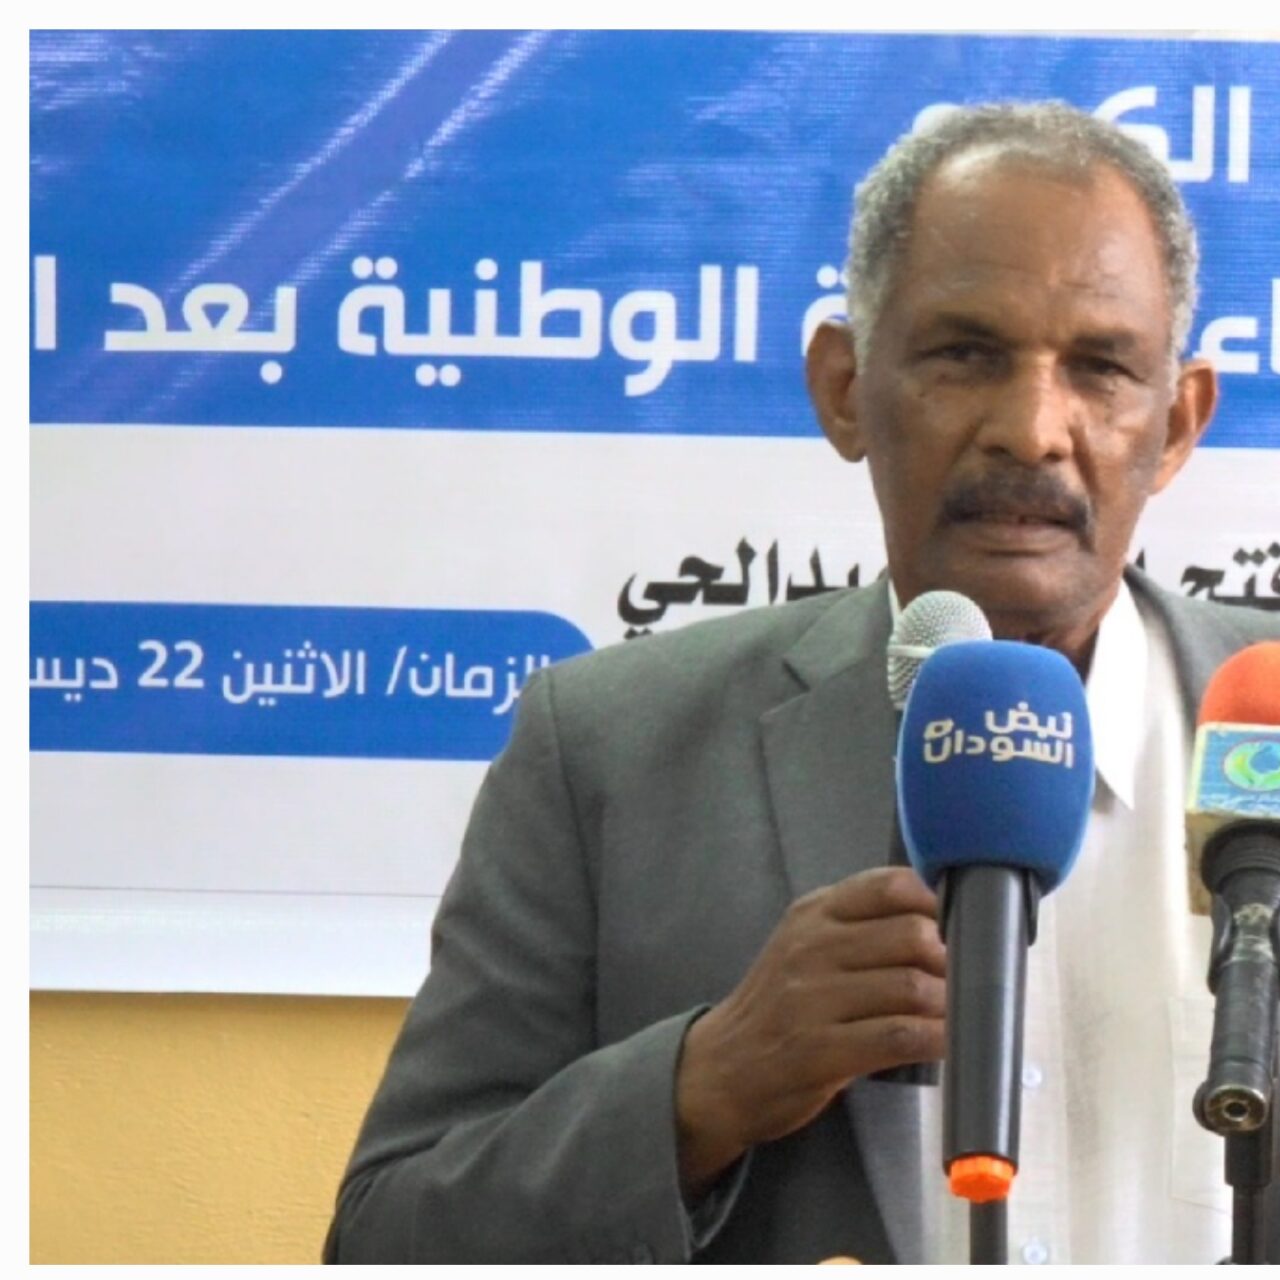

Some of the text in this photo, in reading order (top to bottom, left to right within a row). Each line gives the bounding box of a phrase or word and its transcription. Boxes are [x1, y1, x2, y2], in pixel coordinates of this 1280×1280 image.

[104, 282, 297, 384] بعد
[338, 256, 759, 397] الوطنية
[138, 640, 205, 688] 22
[222, 641, 365, 706] الاثنين
